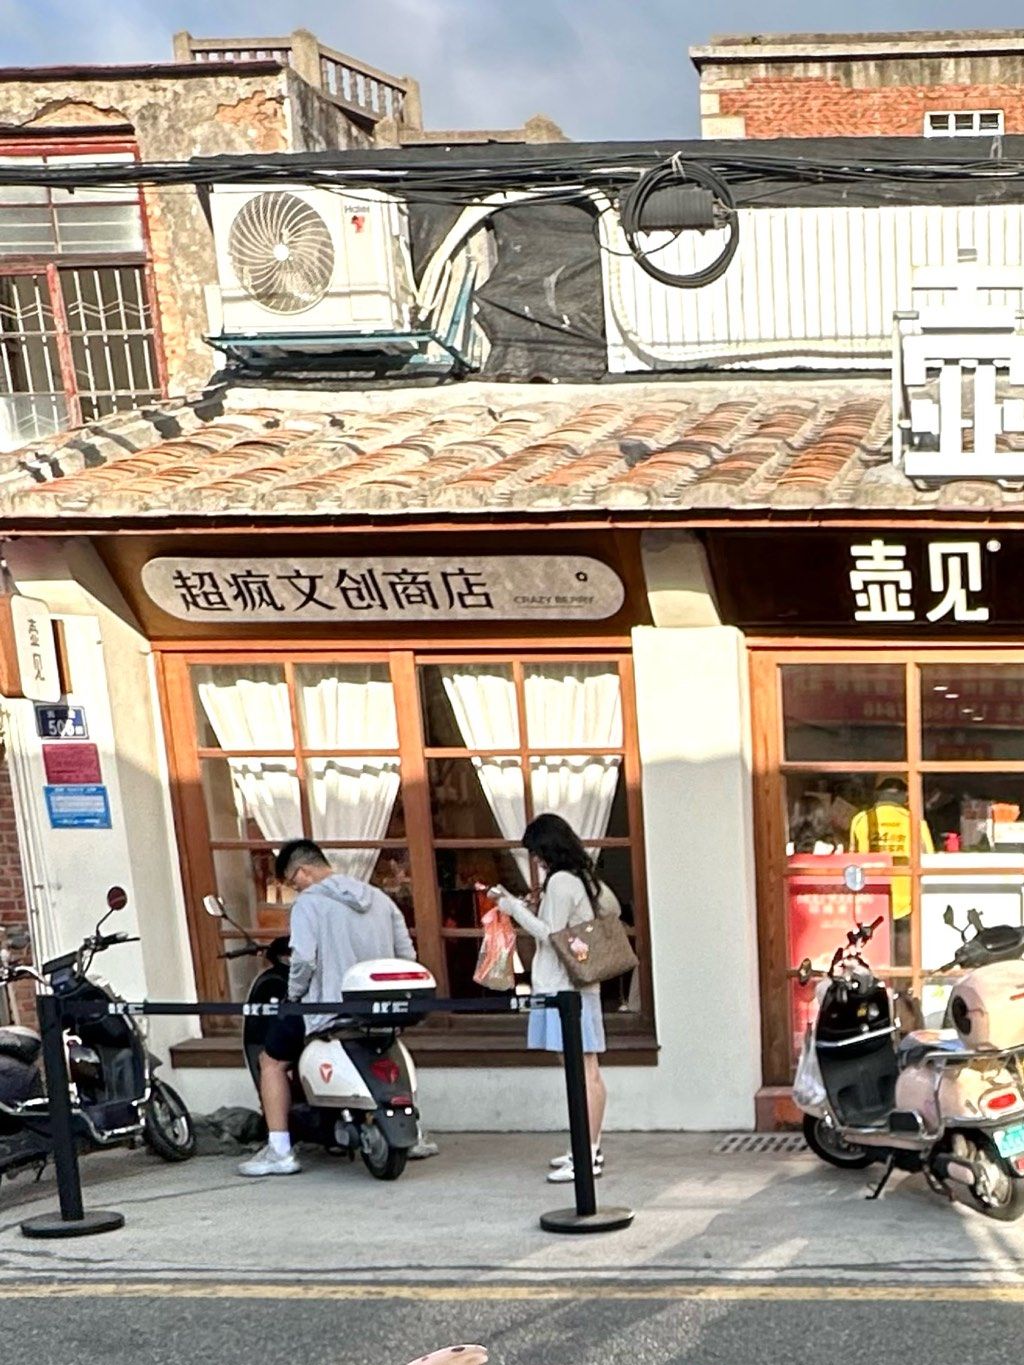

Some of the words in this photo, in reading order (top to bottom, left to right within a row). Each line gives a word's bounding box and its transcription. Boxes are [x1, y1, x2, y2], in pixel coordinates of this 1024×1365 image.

[172, 568, 494, 612] 超疯文创商店
[850, 539, 989, 622] 壶见
